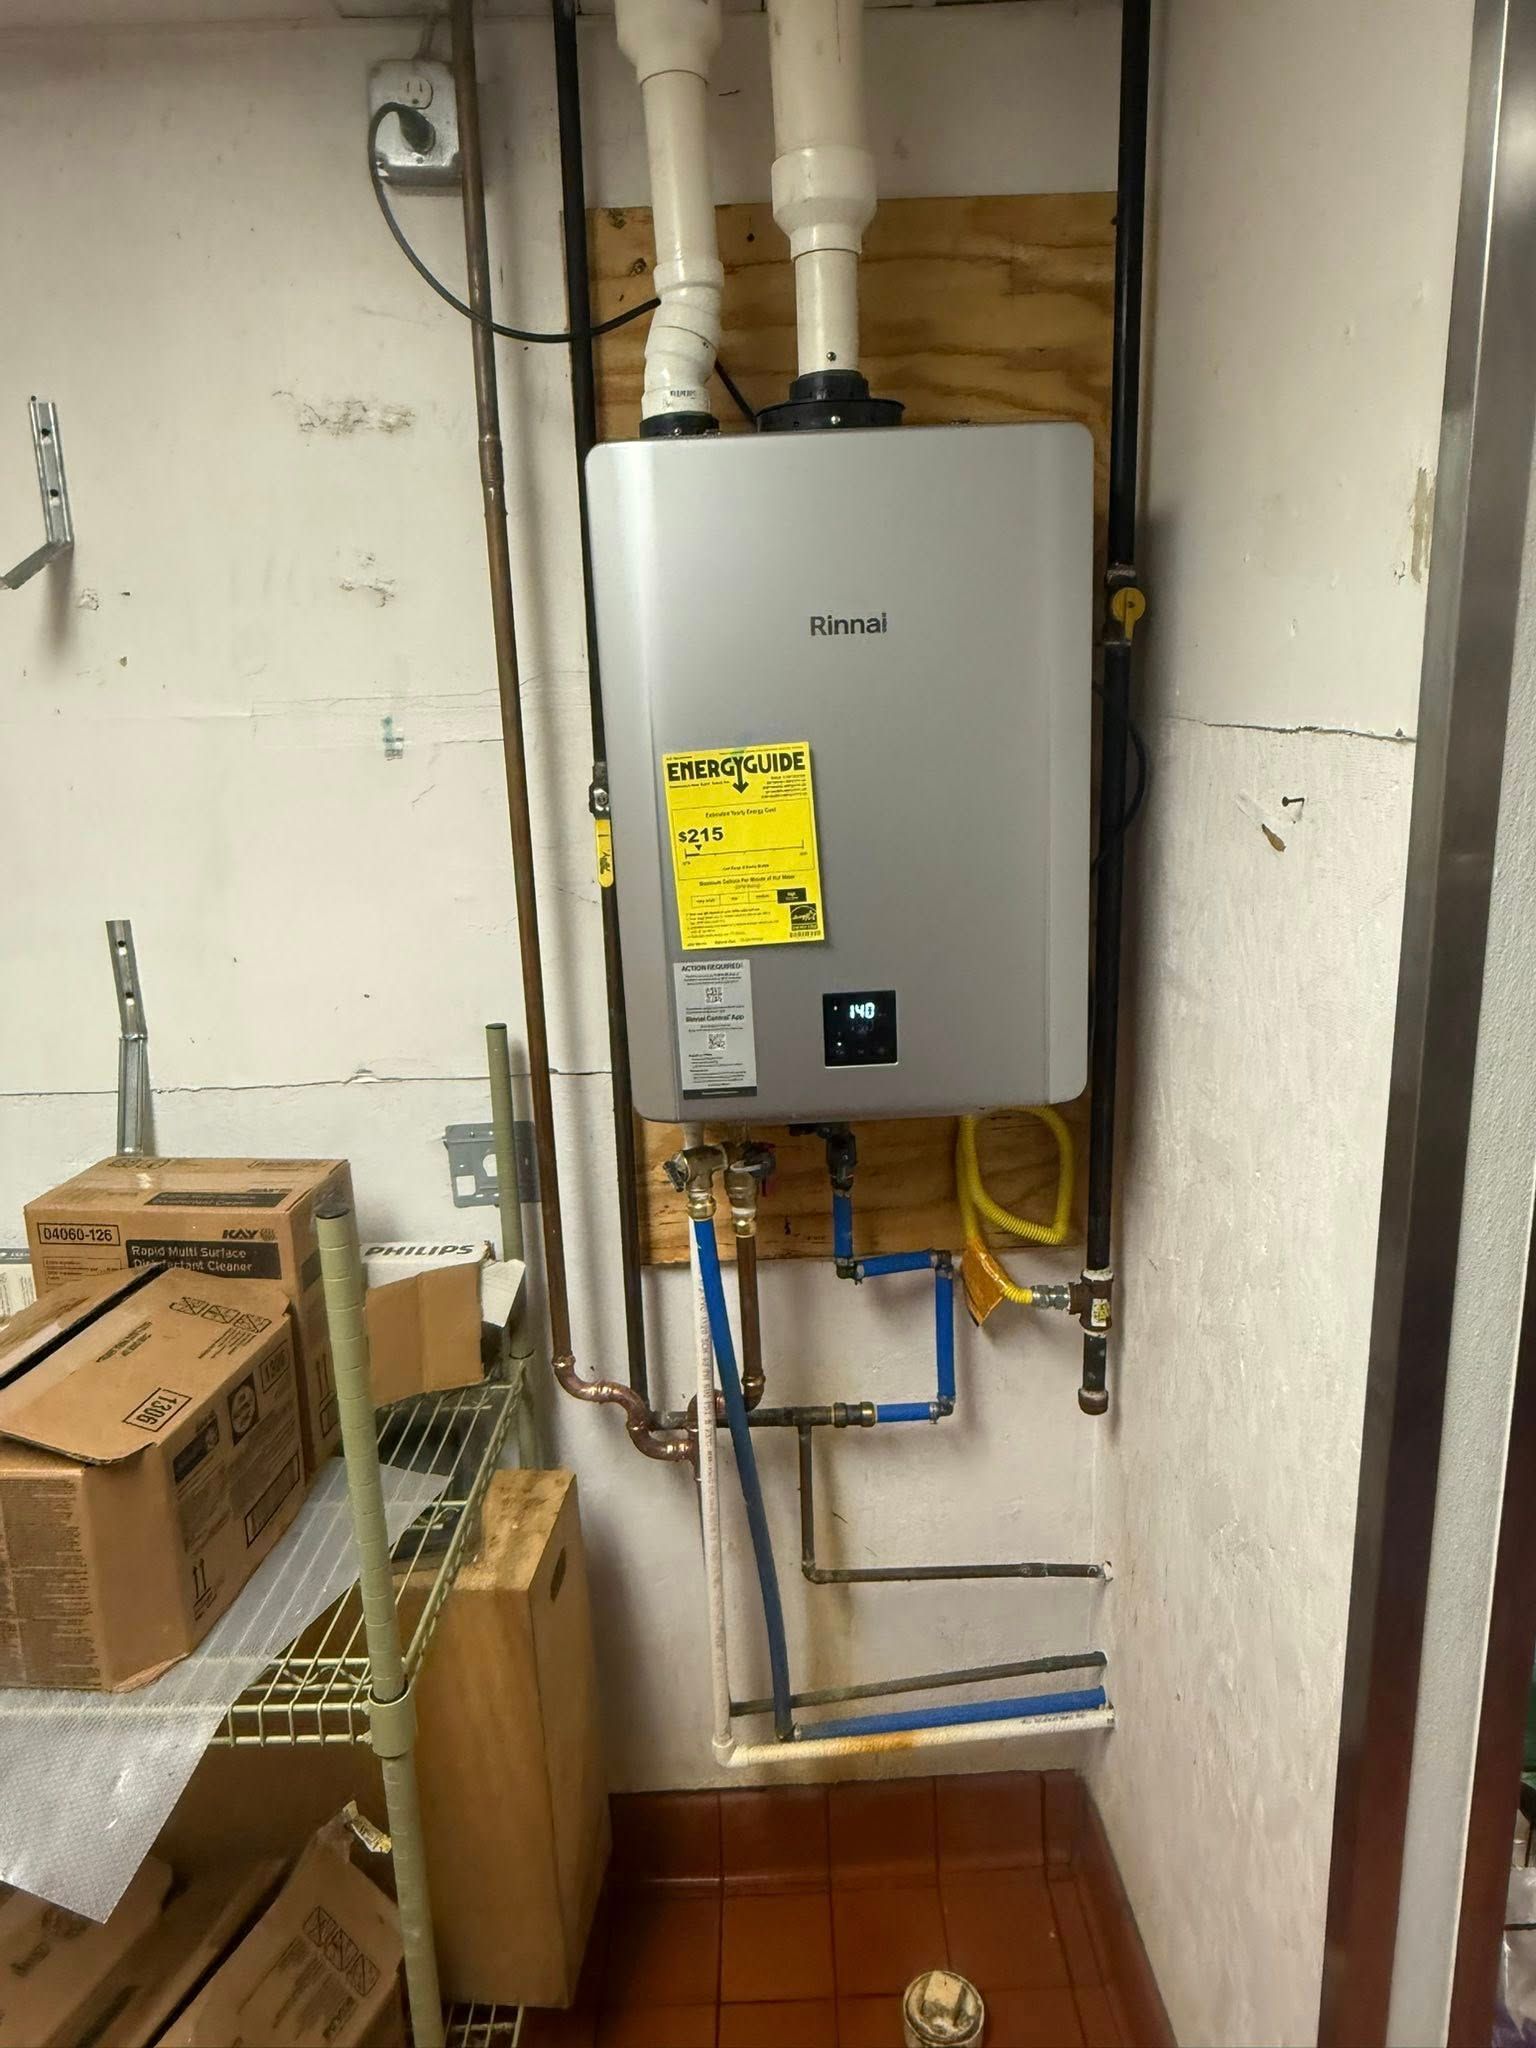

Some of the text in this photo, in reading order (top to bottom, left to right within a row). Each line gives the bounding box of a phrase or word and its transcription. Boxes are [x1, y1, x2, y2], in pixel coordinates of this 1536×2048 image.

[810, 612, 887, 636] Rinnai
[666, 751, 806, 784] ENERGYGUIDE
[678, 826, 724, 843] $215
[681, 964, 706, 972] ACTION
[849, 1002, 875, 1019] 140
[43, 1227, 113, 1242] 04060-126
[222, 1229, 259, 1240] KAY
[131, 1245, 247, 1259] Rapid Multi Surface
[364, 1245, 474, 1257] PHILIPS
[207, 1260, 252, 1272] Cleaner
[136, 1395, 178, 1425] 1306
